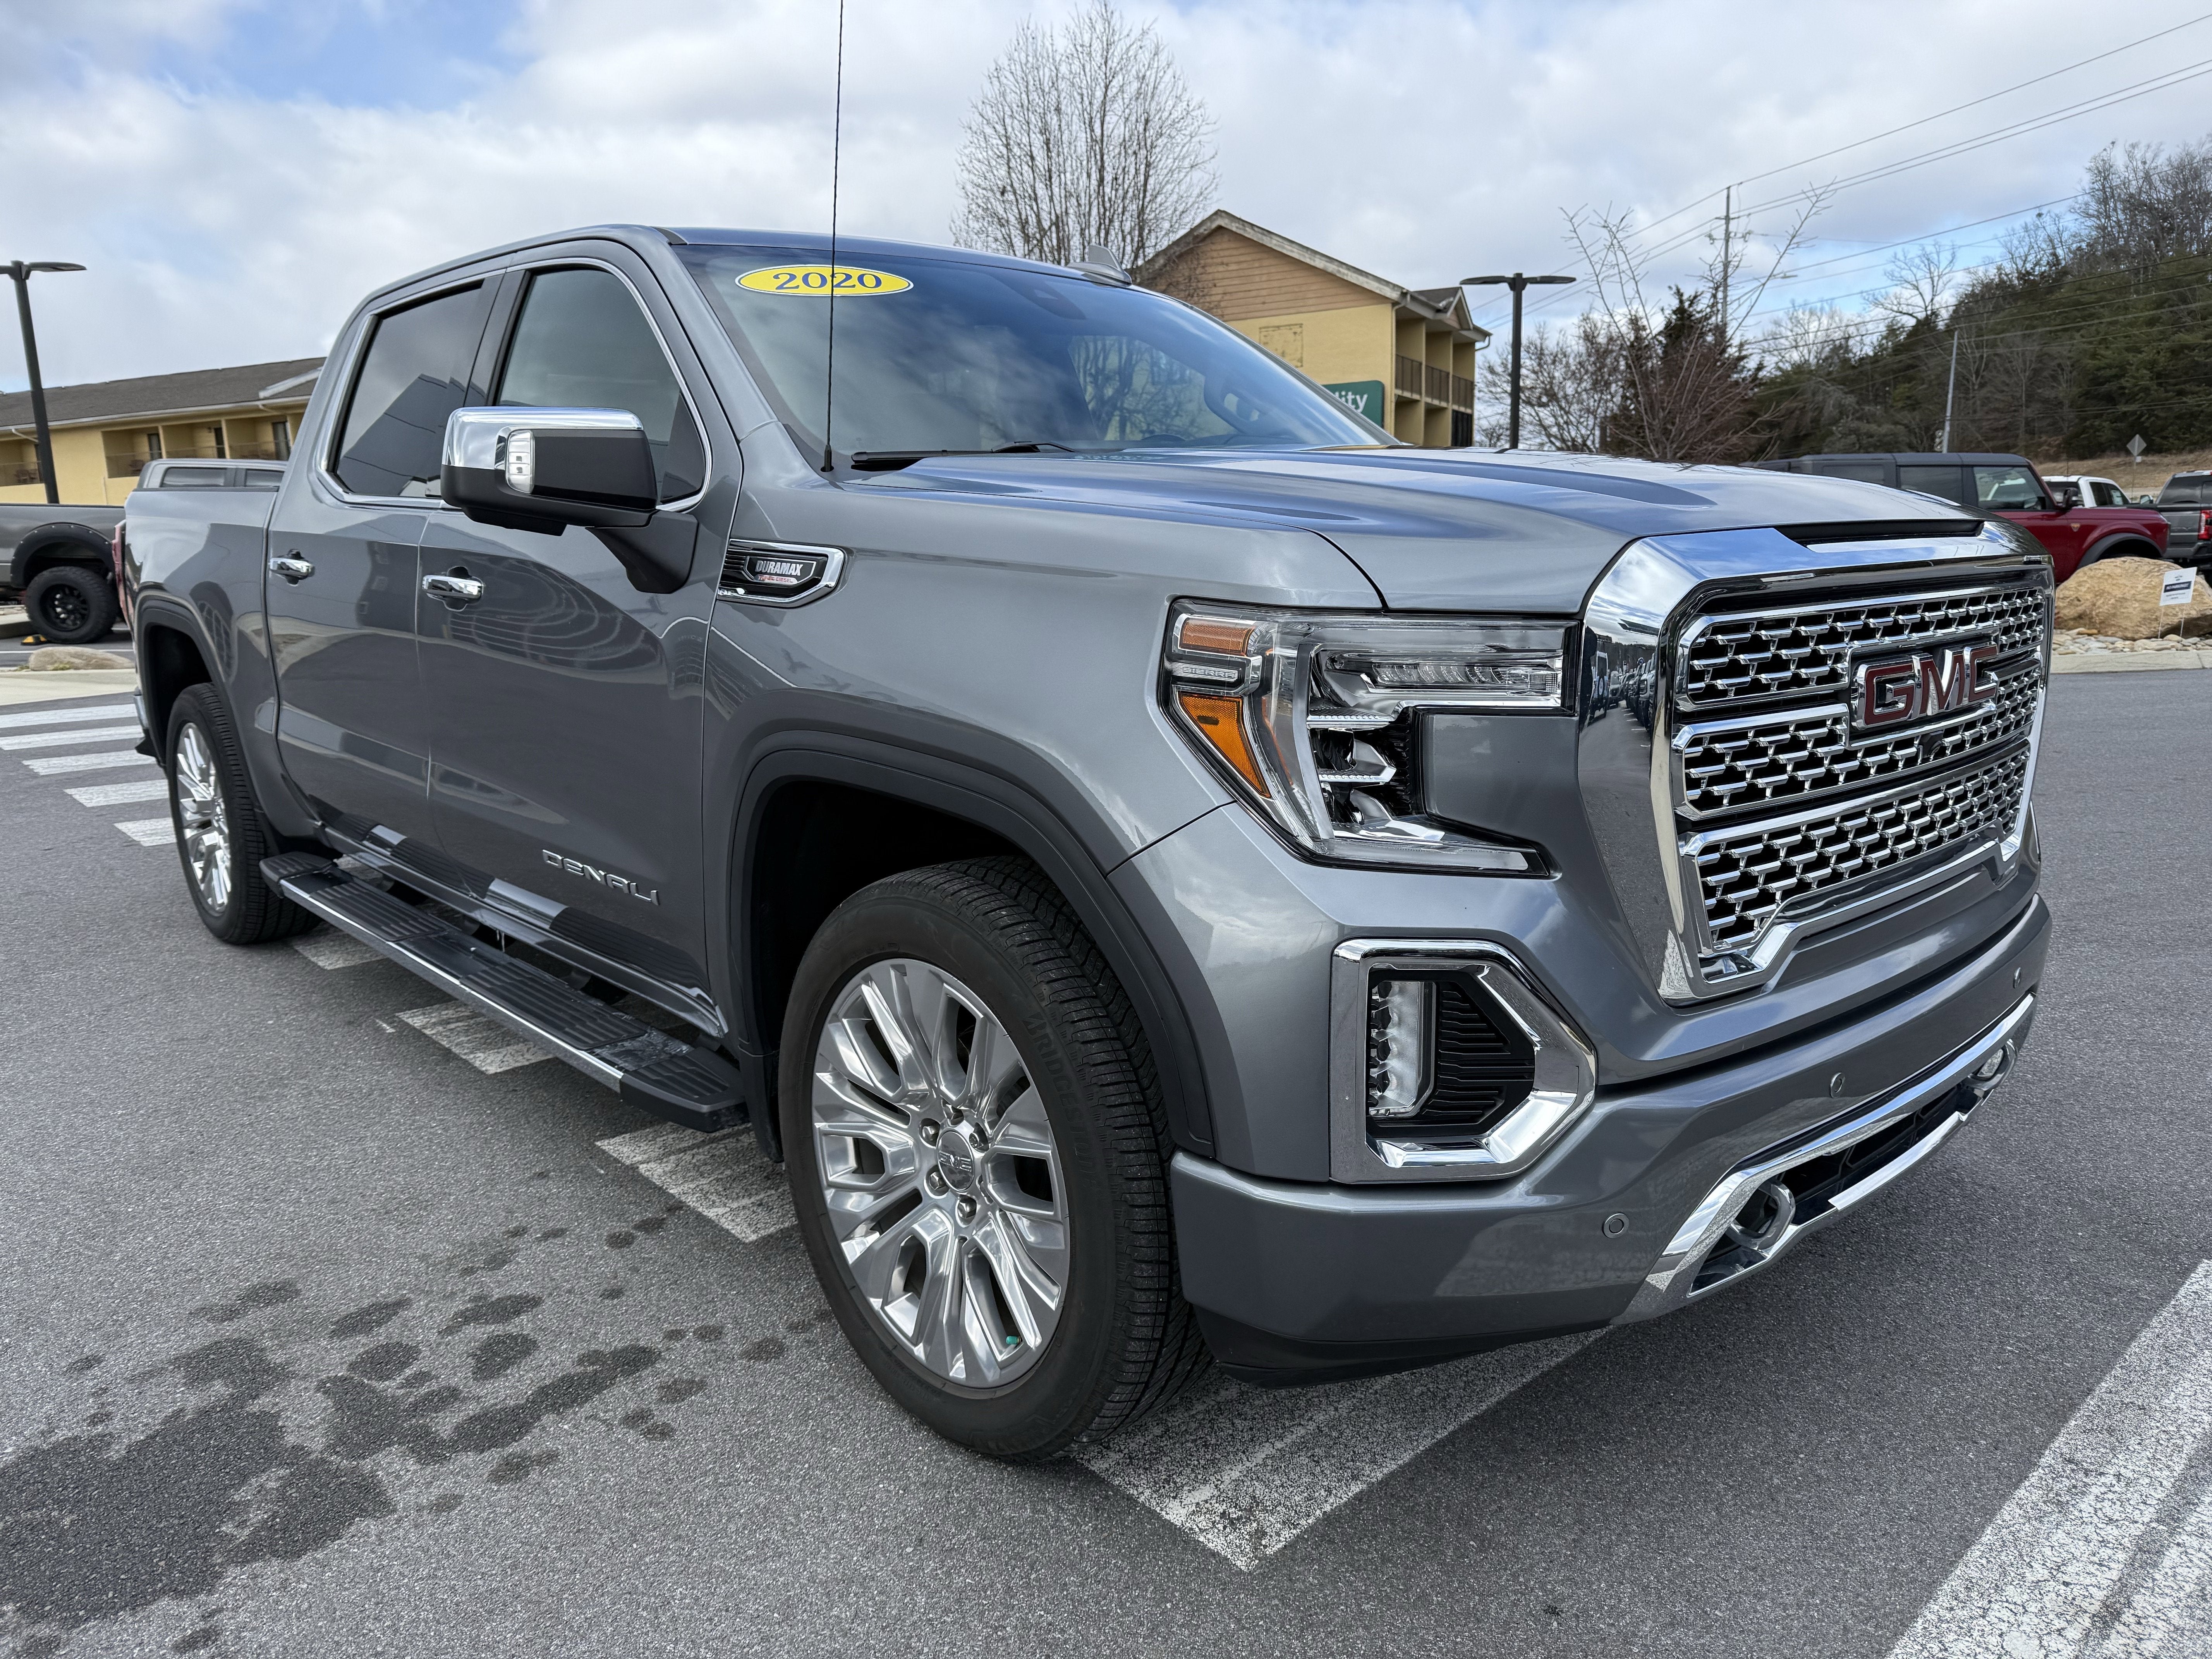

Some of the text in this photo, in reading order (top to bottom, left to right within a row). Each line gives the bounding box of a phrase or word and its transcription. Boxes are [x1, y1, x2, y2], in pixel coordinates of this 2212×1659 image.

[773, 272, 882, 290] 2020
[755, 560, 803, 576] DURAMAX
[1182, 667, 1235, 678] SIERRA
[1851, 641, 1998, 730] GMC
[542, 850, 660, 905] DENALI
